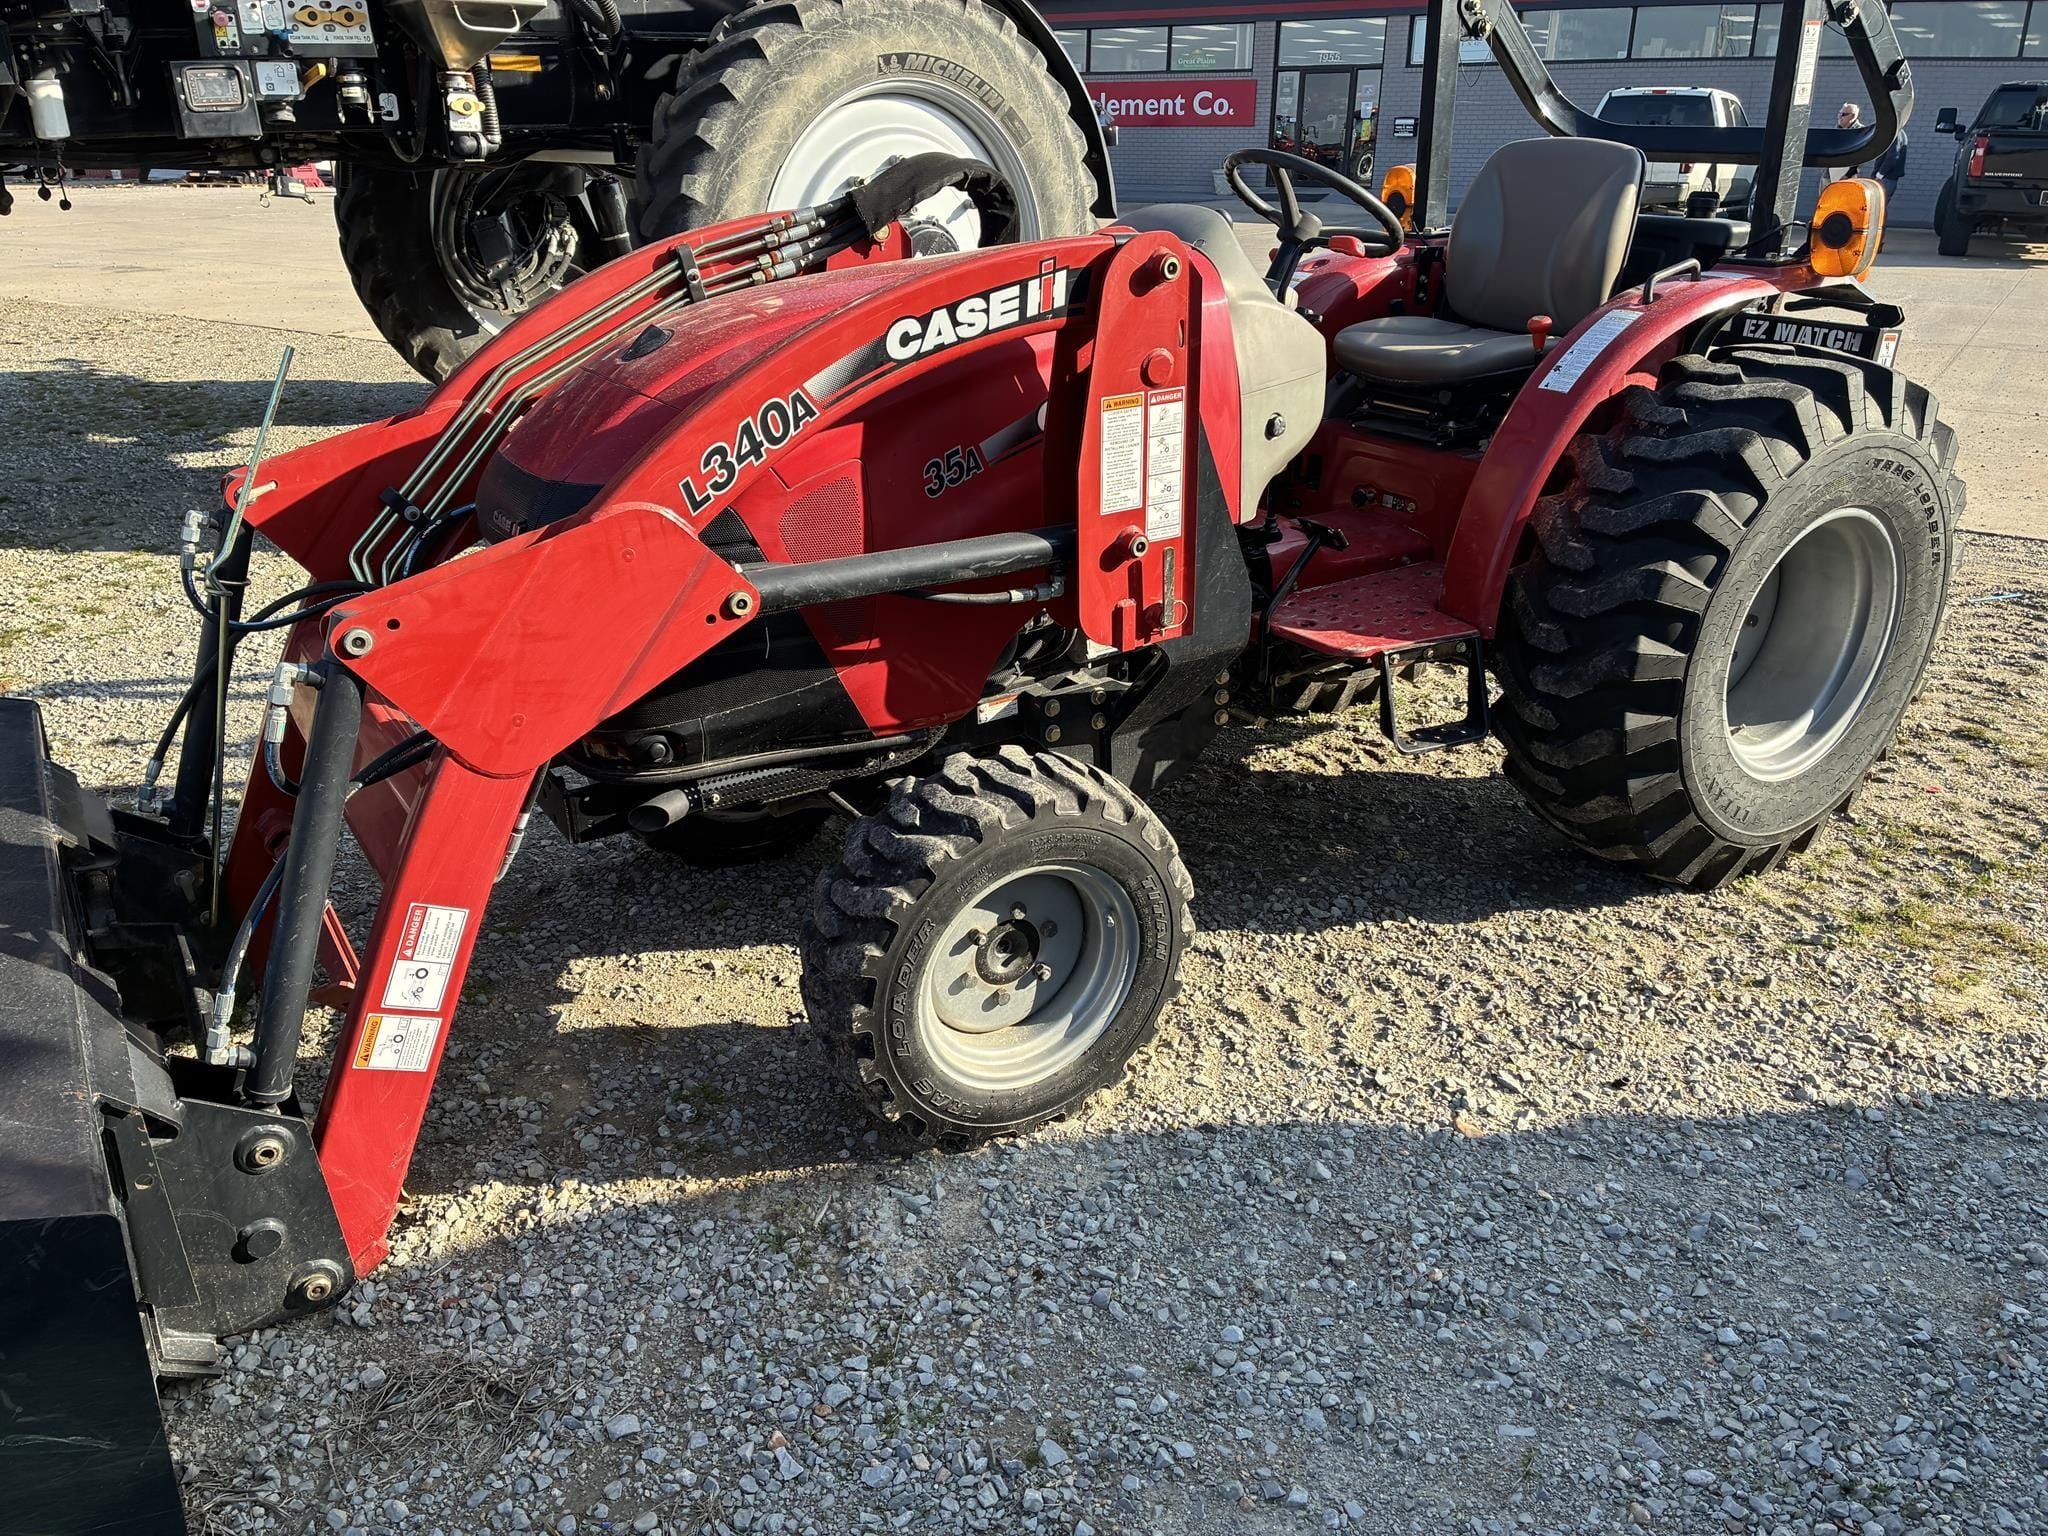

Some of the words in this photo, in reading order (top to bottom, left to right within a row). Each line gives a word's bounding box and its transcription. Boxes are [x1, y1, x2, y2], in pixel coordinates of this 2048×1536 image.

[904, 54, 1000, 109] MICHELIN
[1193, 91, 1235, 116] Co.
[886, 284, 1020, 360] CASE
[1742, 319, 1770, 340] EZ
[1773, 322, 1863, 352] MATCH
[1113, 397, 1139, 407] WARNING
[1156, 392, 1182, 402] DANGER
[679, 389, 820, 517] L340A
[923, 445, 984, 498] 35A
[1868, 457, 1916, 483] TRAC
[1913, 483, 1941, 567] LOADER
[1704, 776, 1752, 826] TITAN
[406, 909, 424, 946] DANGER
[1140, 874, 1169, 962] TITAN
[892, 918, 936, 1057] LOADER
[363, 1020, 378, 1053] WARNING
